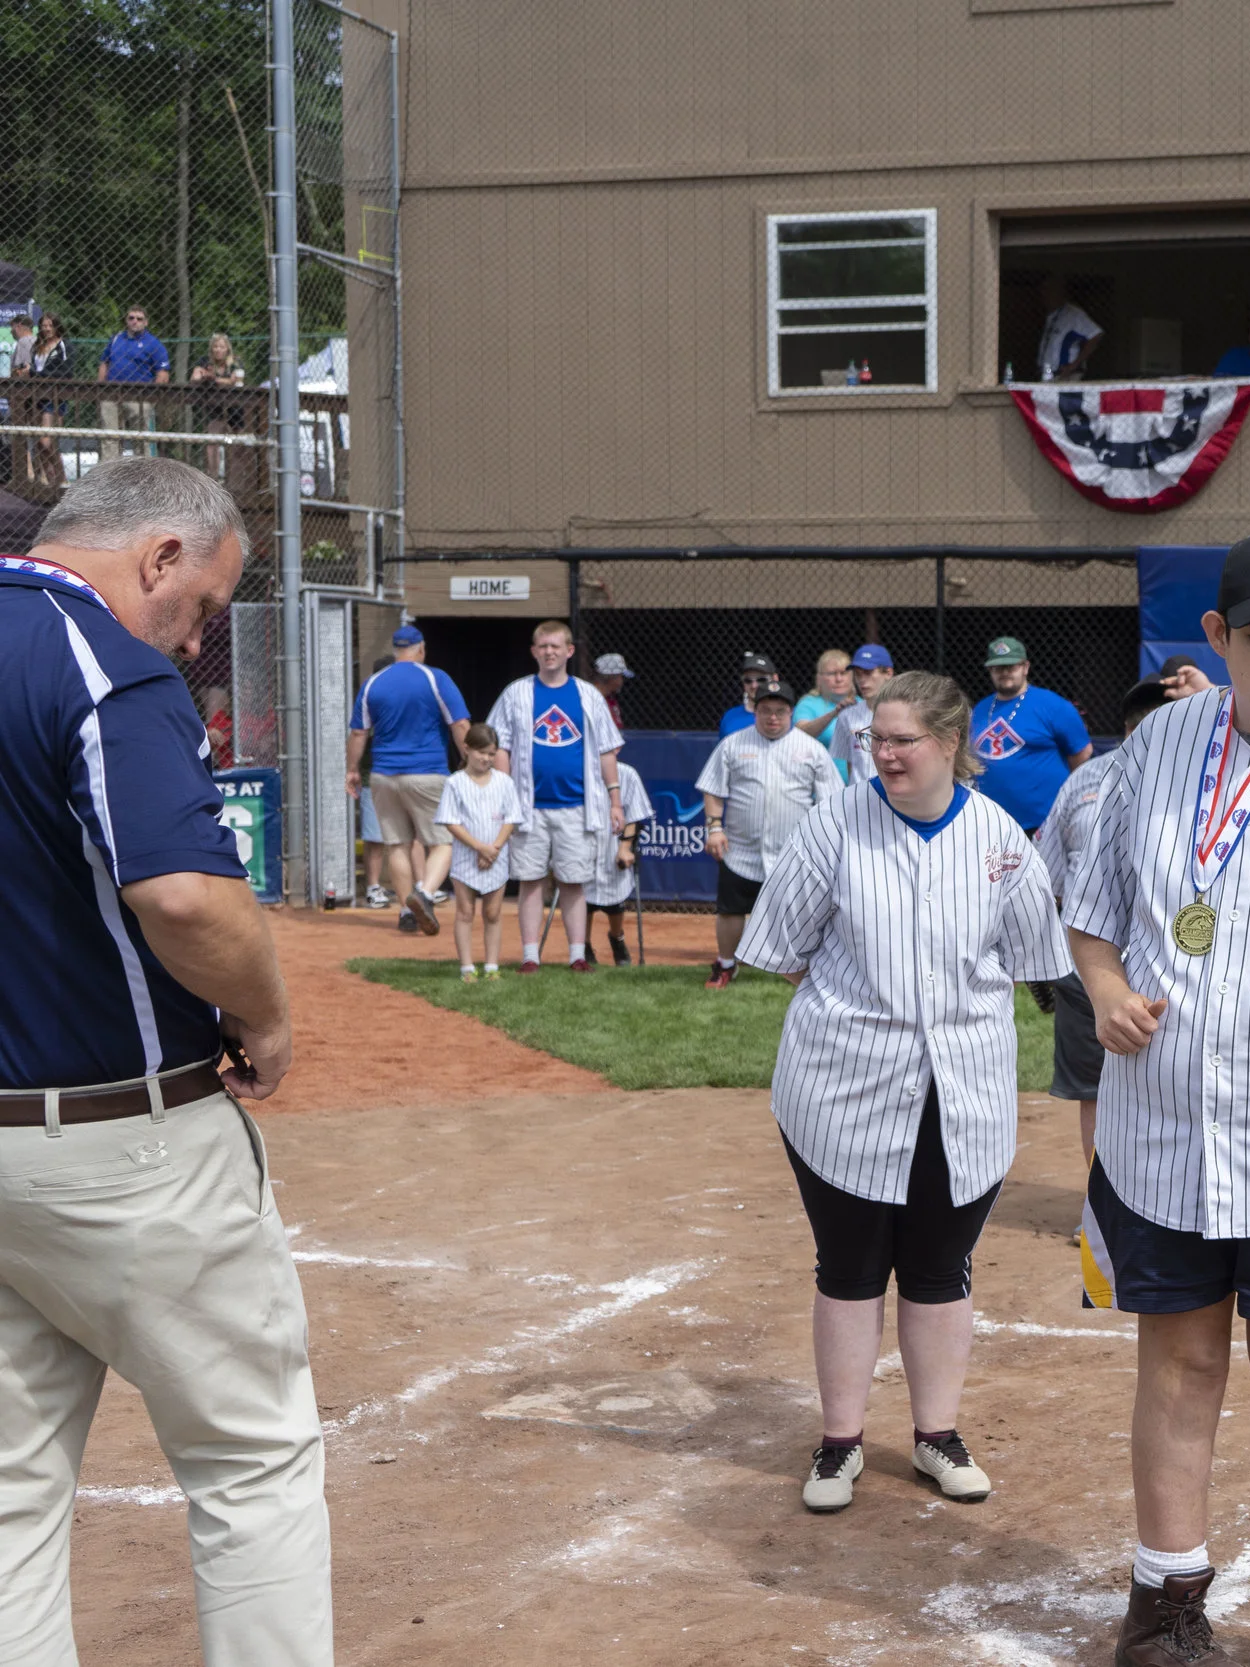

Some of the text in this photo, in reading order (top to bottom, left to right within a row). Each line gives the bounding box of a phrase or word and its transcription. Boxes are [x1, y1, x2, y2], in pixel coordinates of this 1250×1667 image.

[468, 579, 512, 596] HOME
[239, 782, 264, 797] AT
[673, 844, 692, 858] PA
